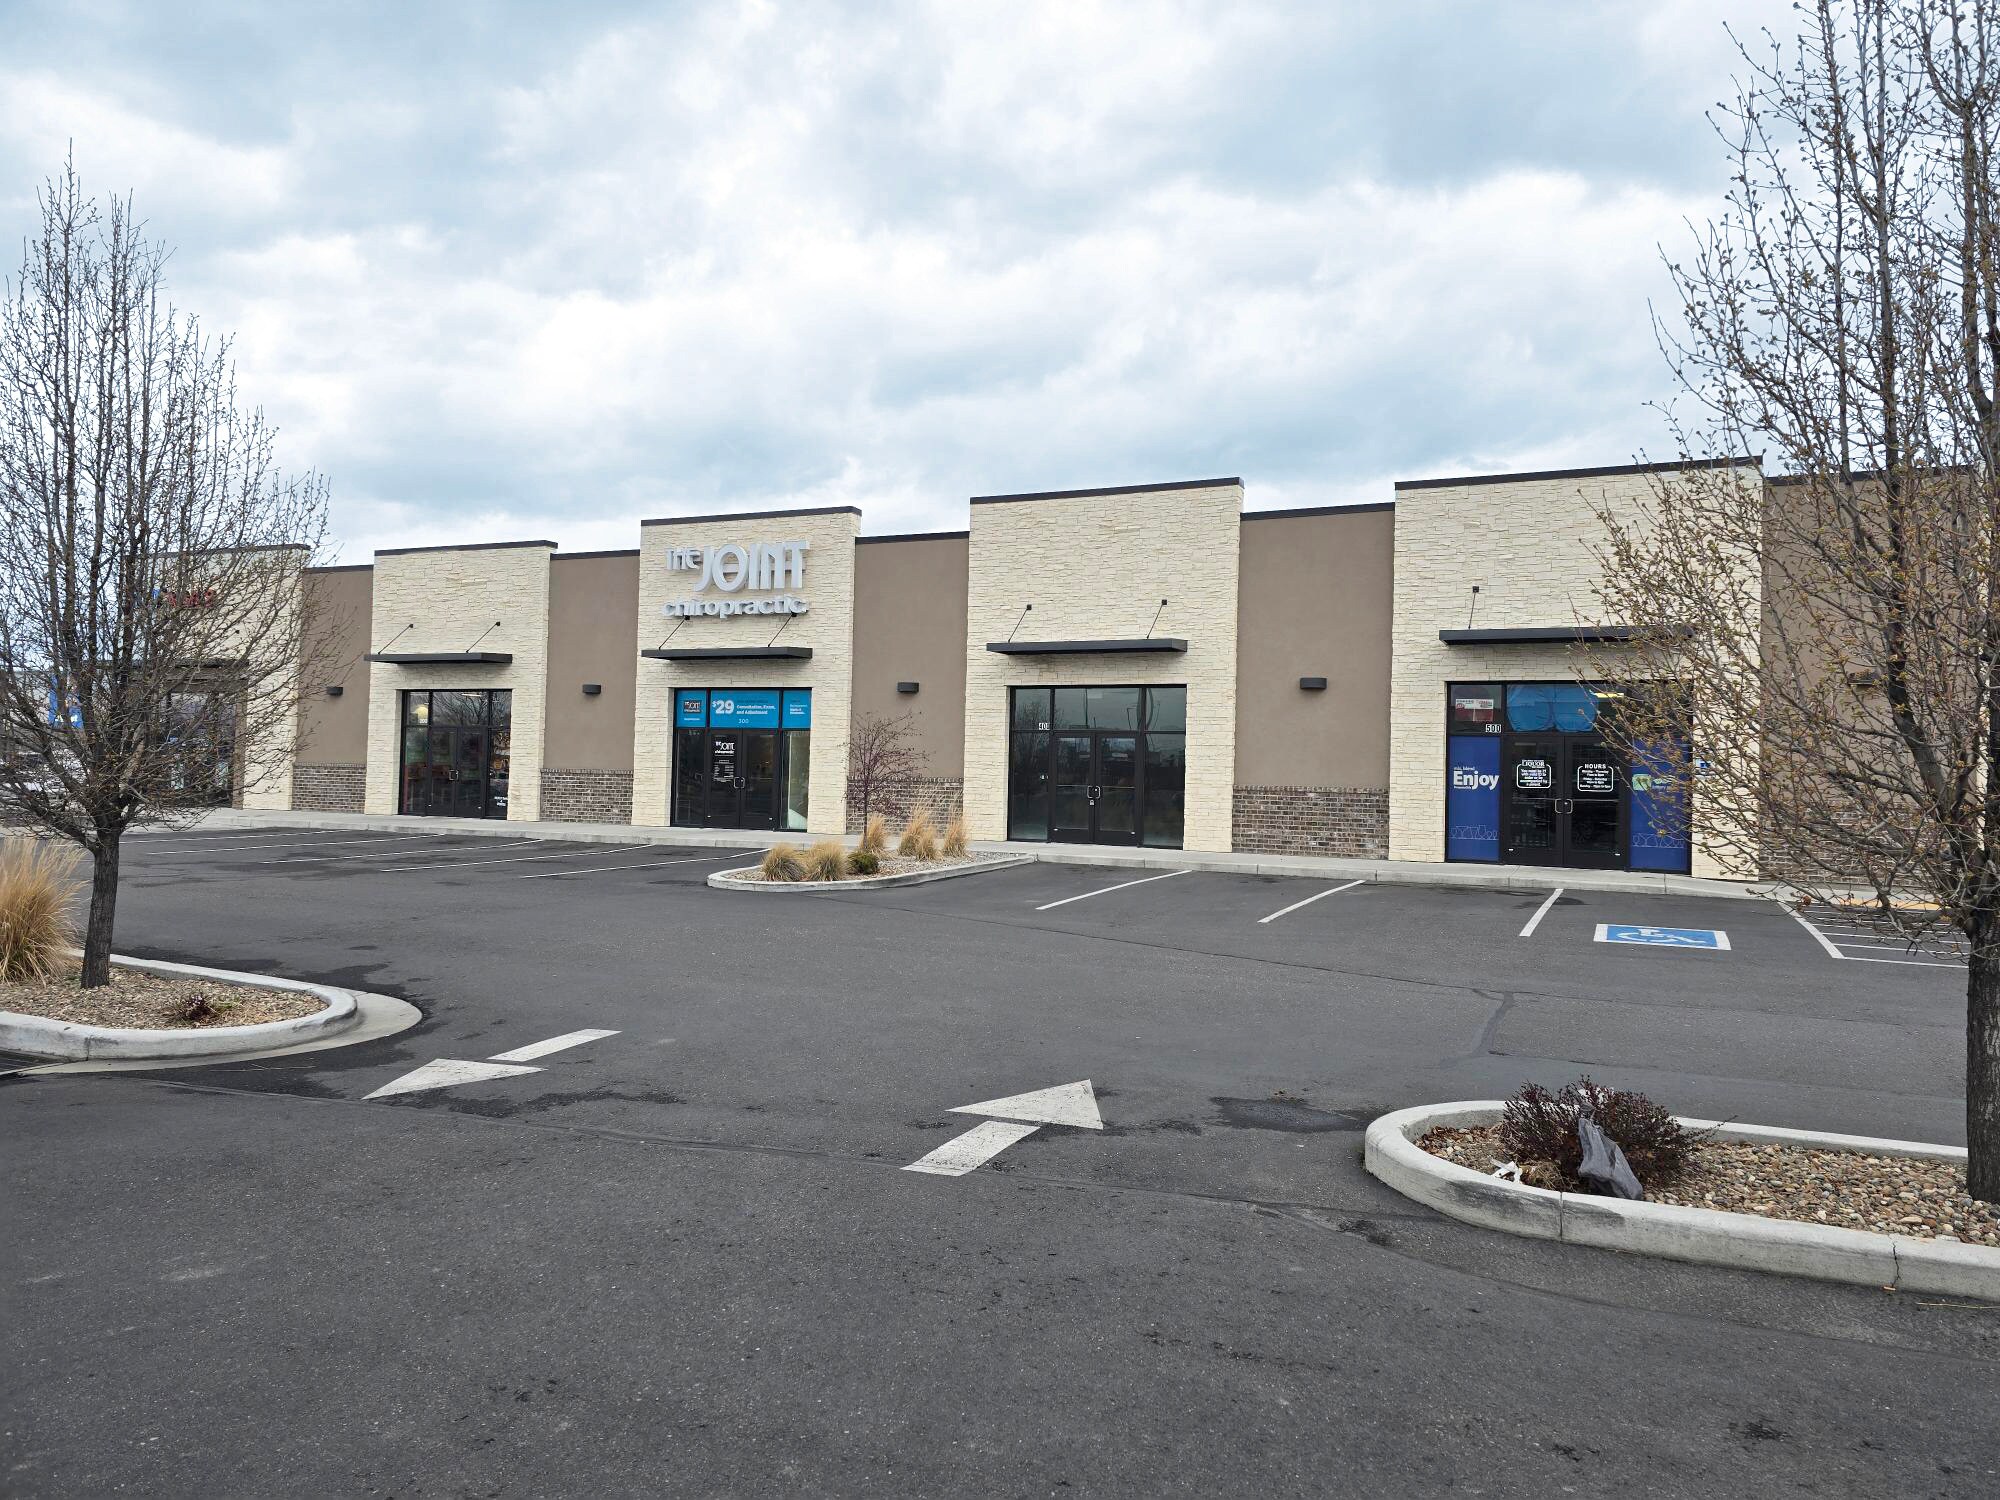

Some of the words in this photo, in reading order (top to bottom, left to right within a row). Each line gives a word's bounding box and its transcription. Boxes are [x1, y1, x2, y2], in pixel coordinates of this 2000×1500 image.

[693, 540, 810, 592] JOINT
[662, 594, 808, 619] chiropractic
[712, 700, 735, 714] $29
[1485, 724, 1501, 732] 500
[1453, 770, 1500, 790] Enjoy
